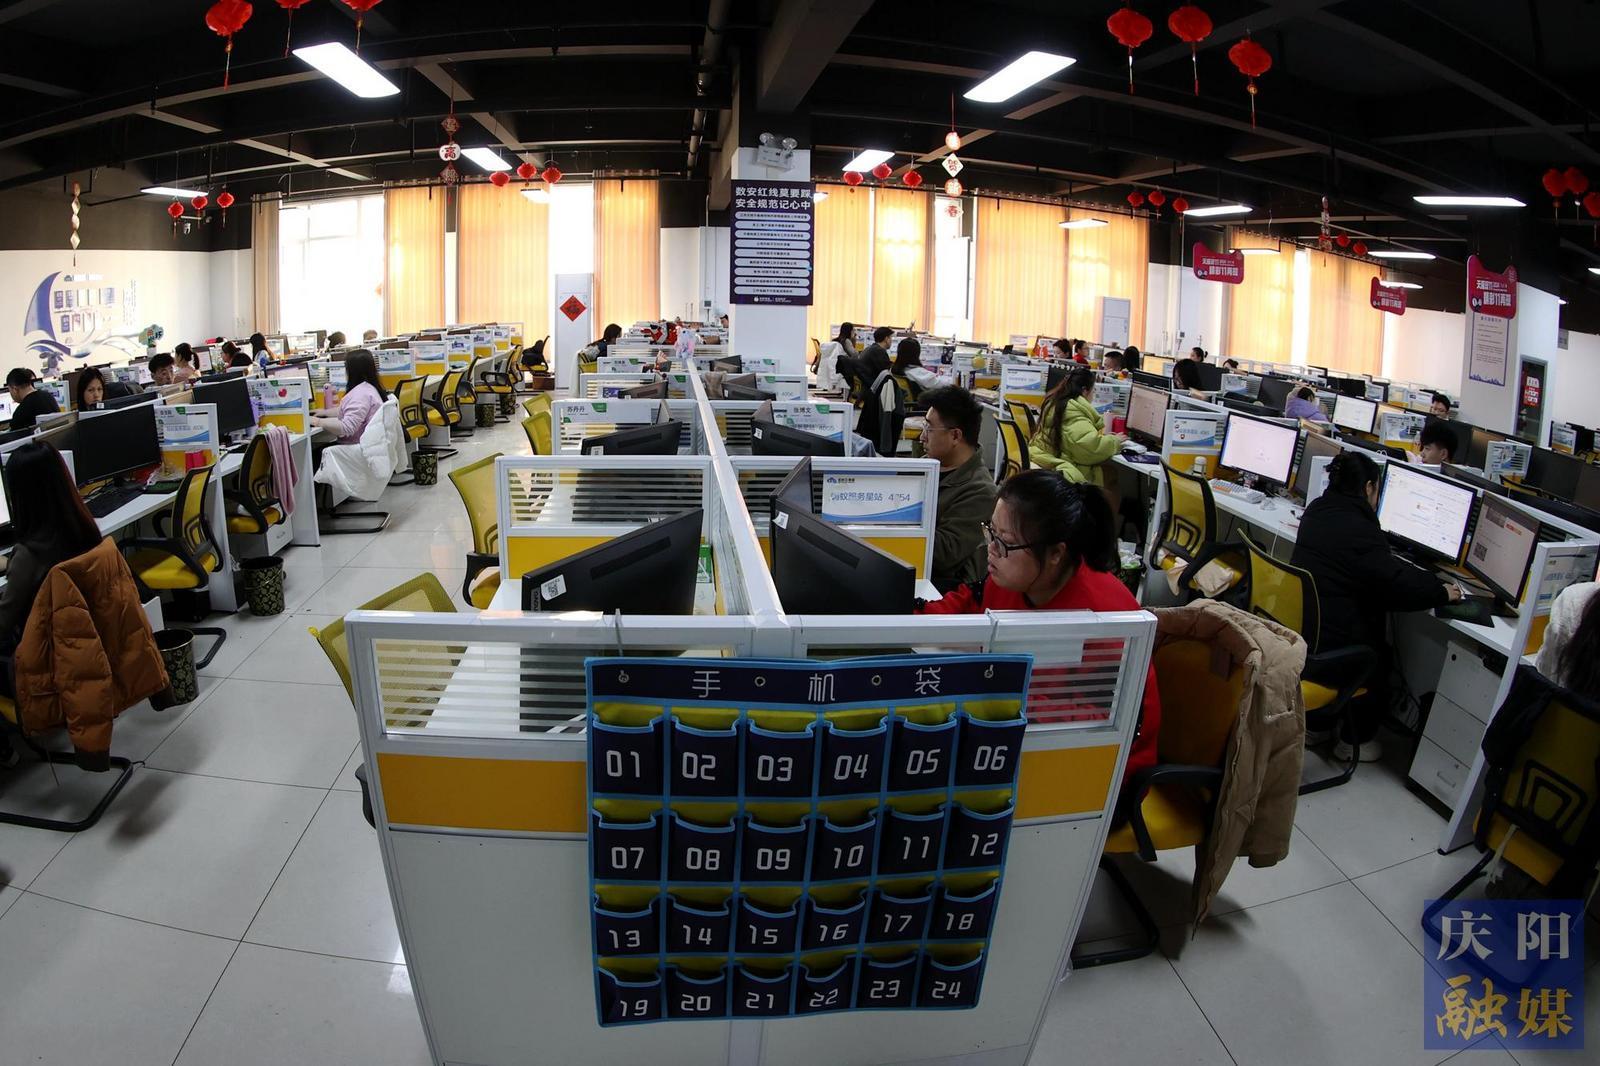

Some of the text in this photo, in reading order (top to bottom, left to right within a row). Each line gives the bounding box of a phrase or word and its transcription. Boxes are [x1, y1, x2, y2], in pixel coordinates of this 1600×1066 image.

[735, 186, 811, 198] 数安红线莫要踩
[735, 199, 811, 211] 安全规范记心中
[606, 745, 1008, 782] 01 02 03 04 05 06
[611, 832, 999, 871] 07 08 09 10 11 12
[608, 912, 974, 949] 13 14 15 16 17 18
[620, 979, 961, 1017] 19 20 21 22 23 24
